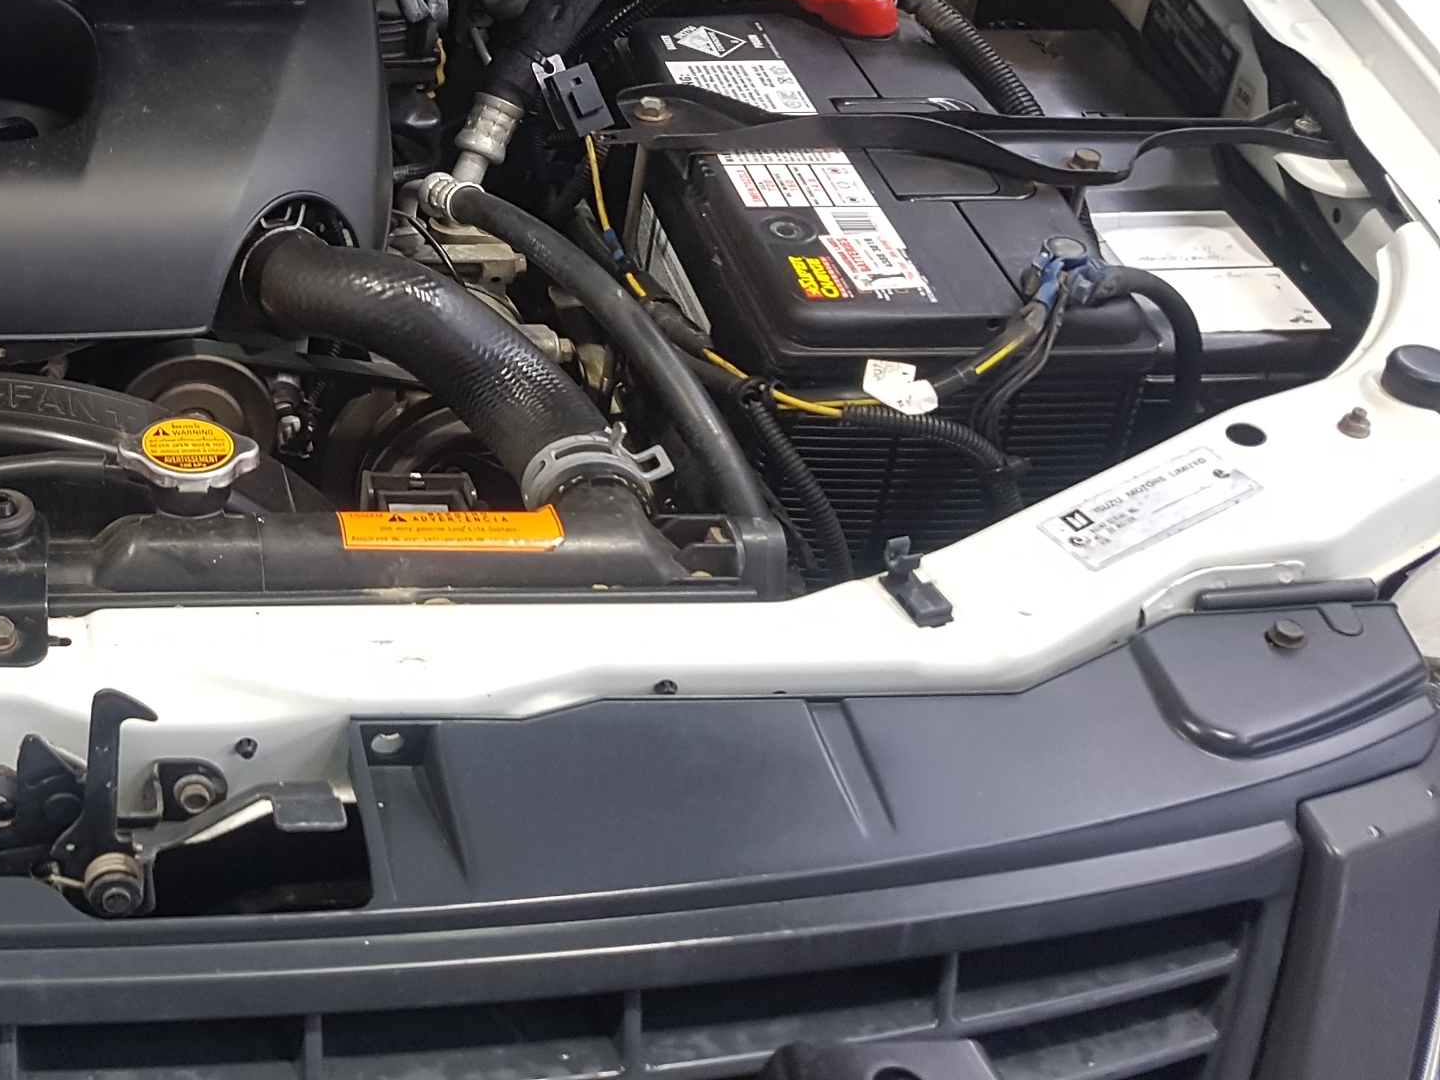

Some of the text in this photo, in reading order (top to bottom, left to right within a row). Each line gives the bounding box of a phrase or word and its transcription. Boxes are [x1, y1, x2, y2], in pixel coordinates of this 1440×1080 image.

[835, 238, 871, 272] BATTERIES
[164, 455, 218, 463] AVERTISSEMENT
[1093, 497, 1122, 514] ISUZU
[1125, 475, 1167, 498] MOTORS
[413, 515, 509, 523] ADVERTENCIA
